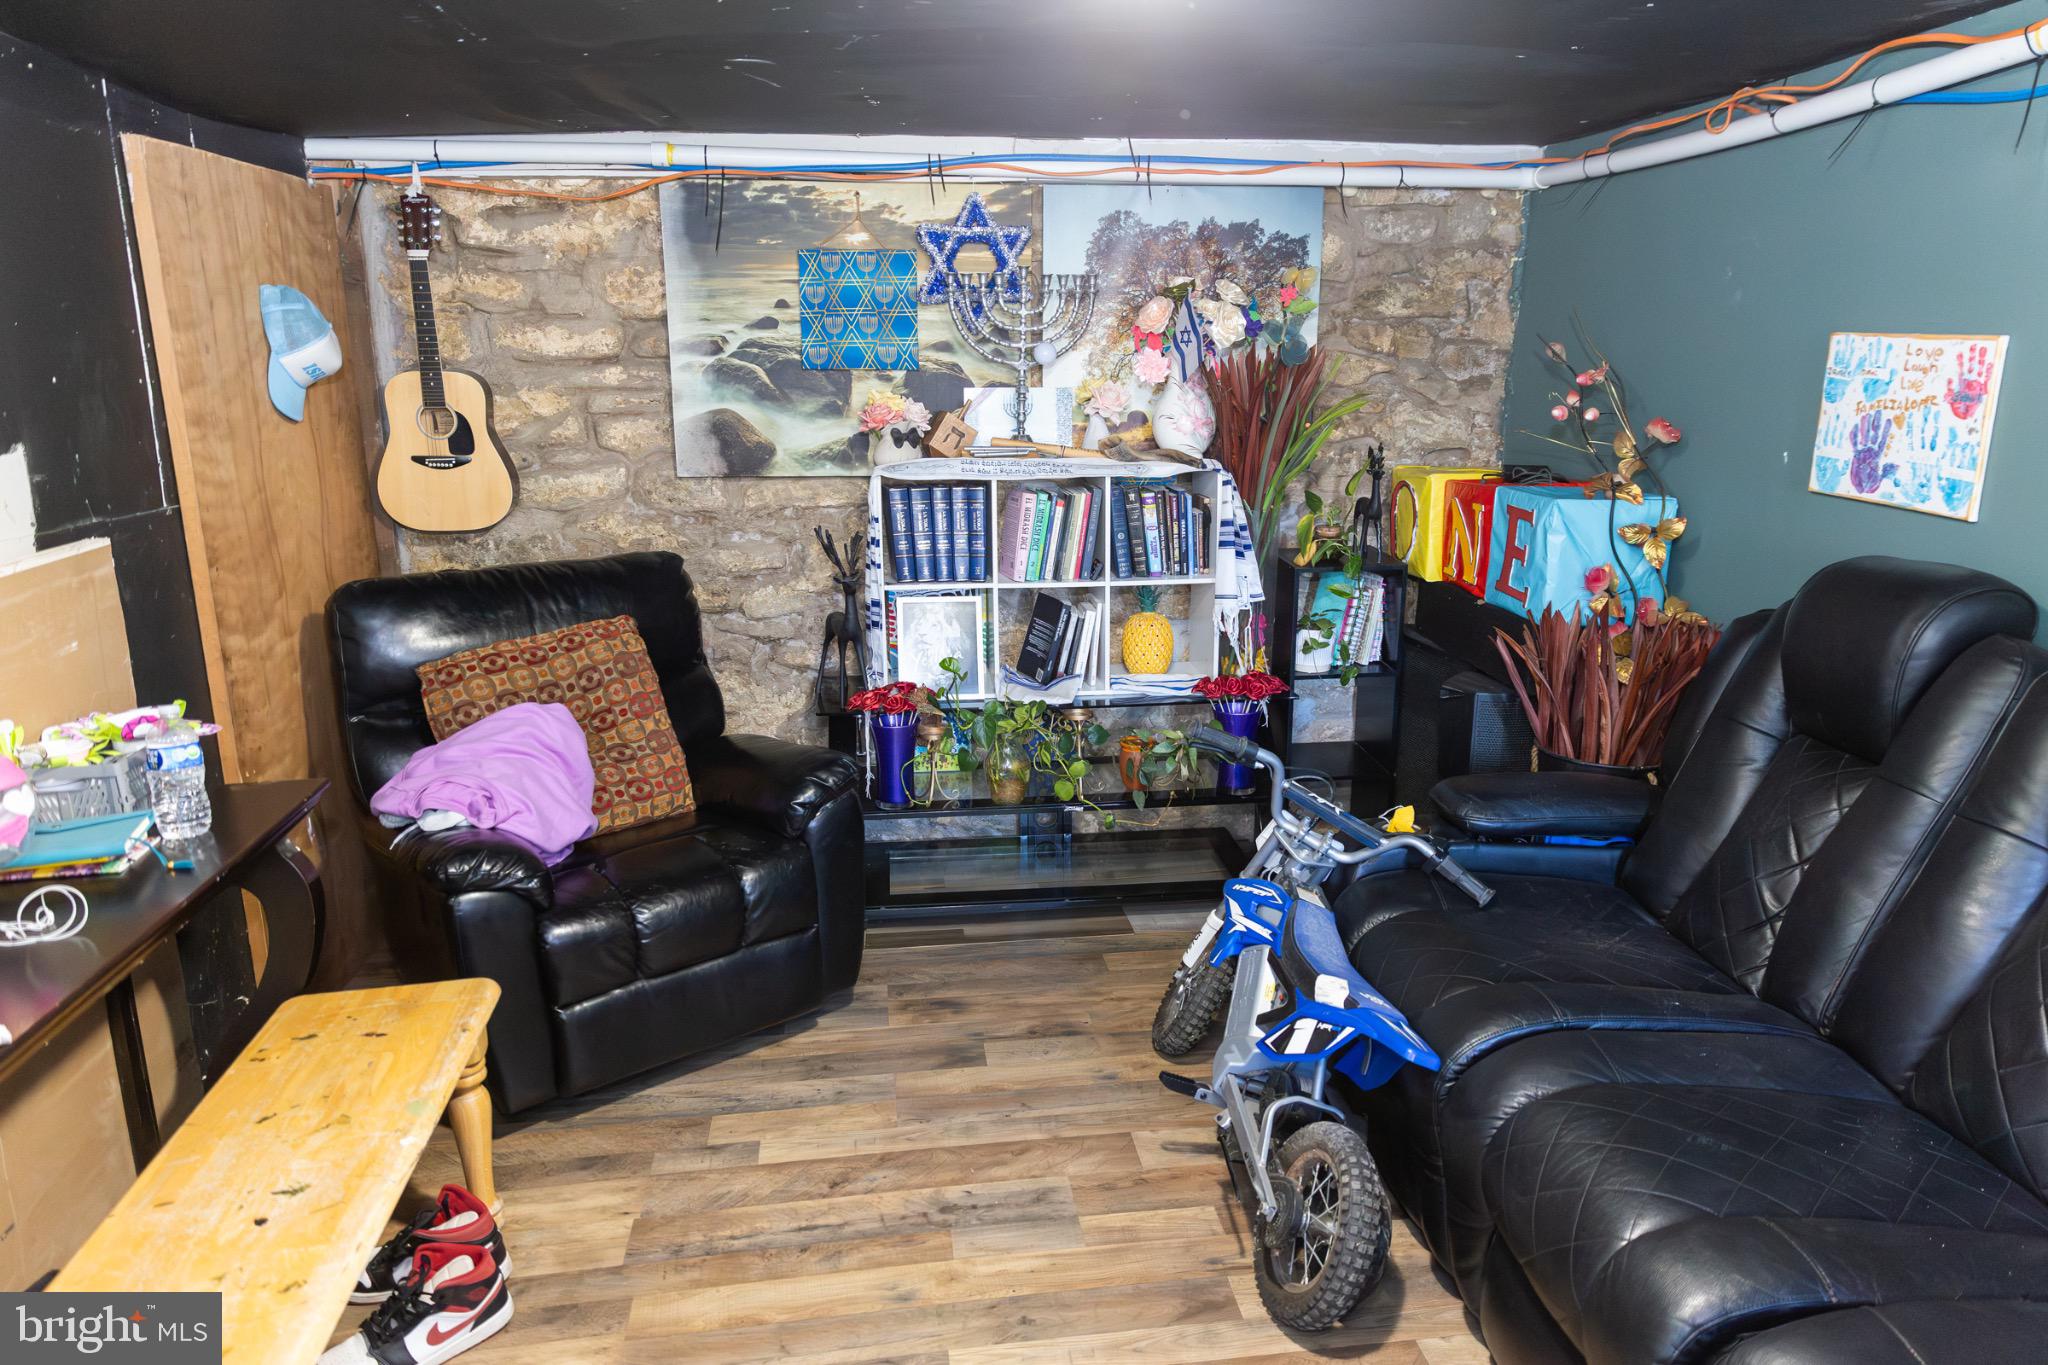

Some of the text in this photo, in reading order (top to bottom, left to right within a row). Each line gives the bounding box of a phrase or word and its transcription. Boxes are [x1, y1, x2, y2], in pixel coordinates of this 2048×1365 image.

[1022, 506, 1032, 535] MIDRASH
[1033, 507, 1045, 536] MIDRASH
[1390, 480, 1535, 609] ONE
